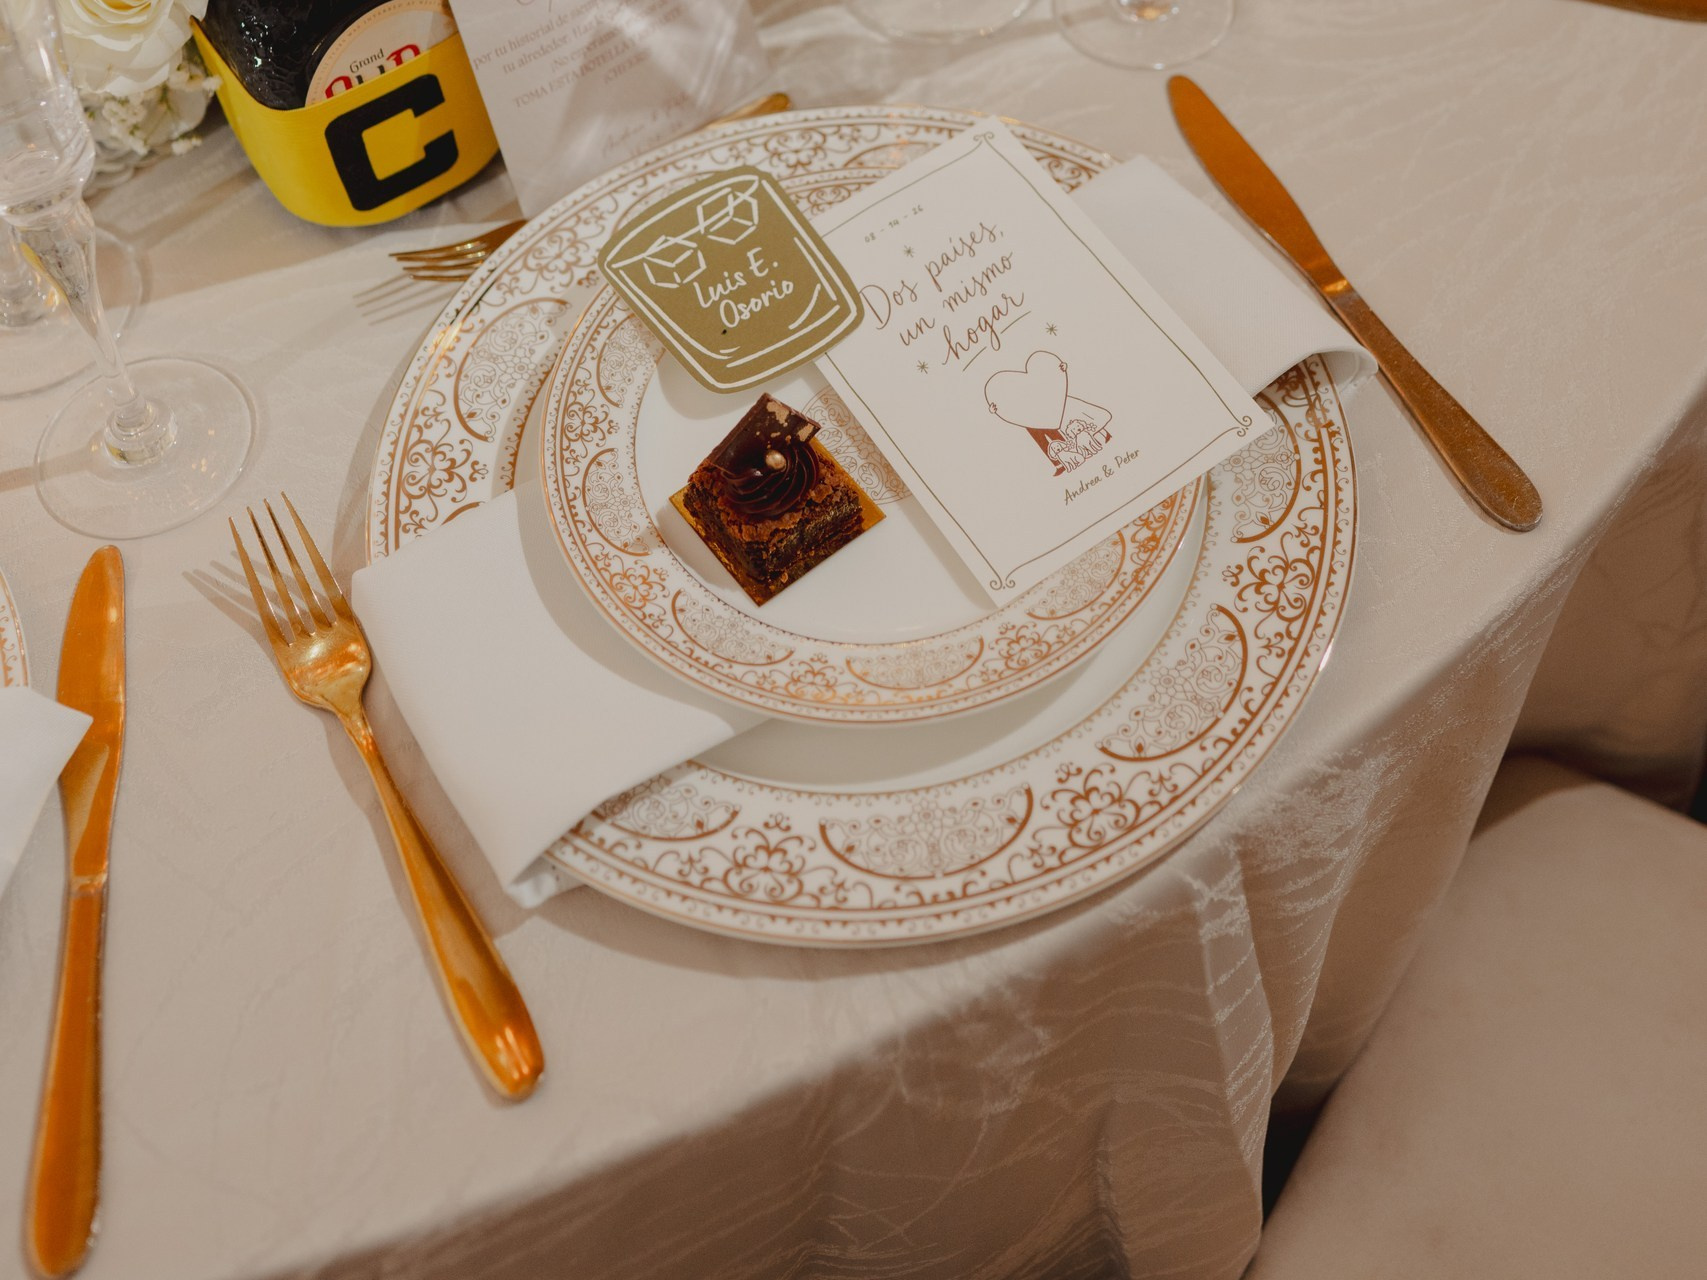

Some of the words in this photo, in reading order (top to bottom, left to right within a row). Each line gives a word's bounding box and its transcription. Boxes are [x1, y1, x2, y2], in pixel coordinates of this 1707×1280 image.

[349, 48, 385, 74] Grand
[473, 51, 492, 70] por
[494, 47, 507, 58] tu
[508, 19, 555, 51] historial
[693, 271, 747, 308] Luis
[746, 247, 778, 277] E.
[719, 280, 794, 328] Osorio
[900, 317, 935, 346] un
[943, 251, 1013, 312] mismo
[859, 280, 918, 330] Dos
[942, 292, 1025, 366] hogar
[1064, 476, 1102, 506] Andrea
[1102, 464, 1115, 478] &
[1114, 449, 1140, 468] Peter
